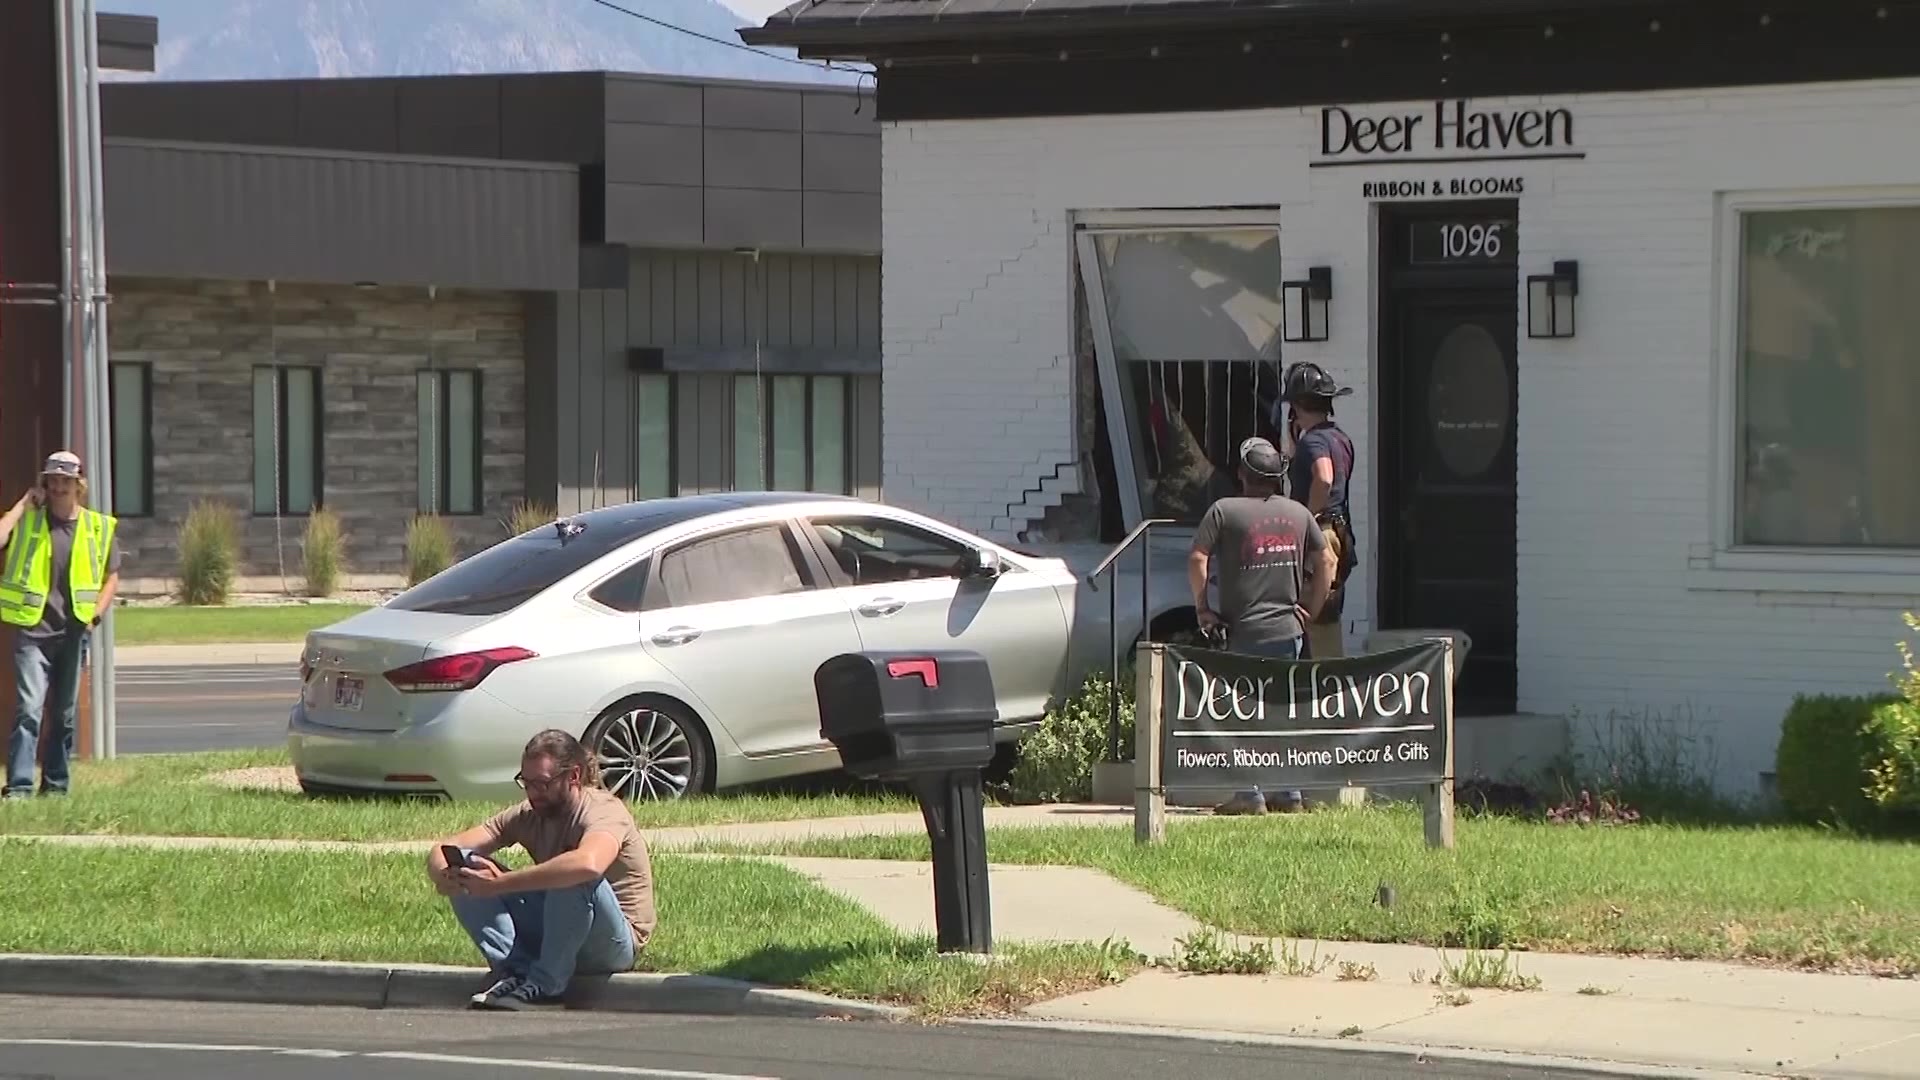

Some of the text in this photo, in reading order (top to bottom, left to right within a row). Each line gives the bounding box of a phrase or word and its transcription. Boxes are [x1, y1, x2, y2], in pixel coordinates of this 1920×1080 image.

[1321, 100, 1573, 156] Deer Haven
[1363, 176, 1524, 198] RIBBON & BLOOMS
[1440, 224, 1501, 258] 1096
[1177, 660, 1430, 721] Deer Haven
[1177, 742, 1430, 768] Flowers, Ribbon, Home Decor & Gifts
